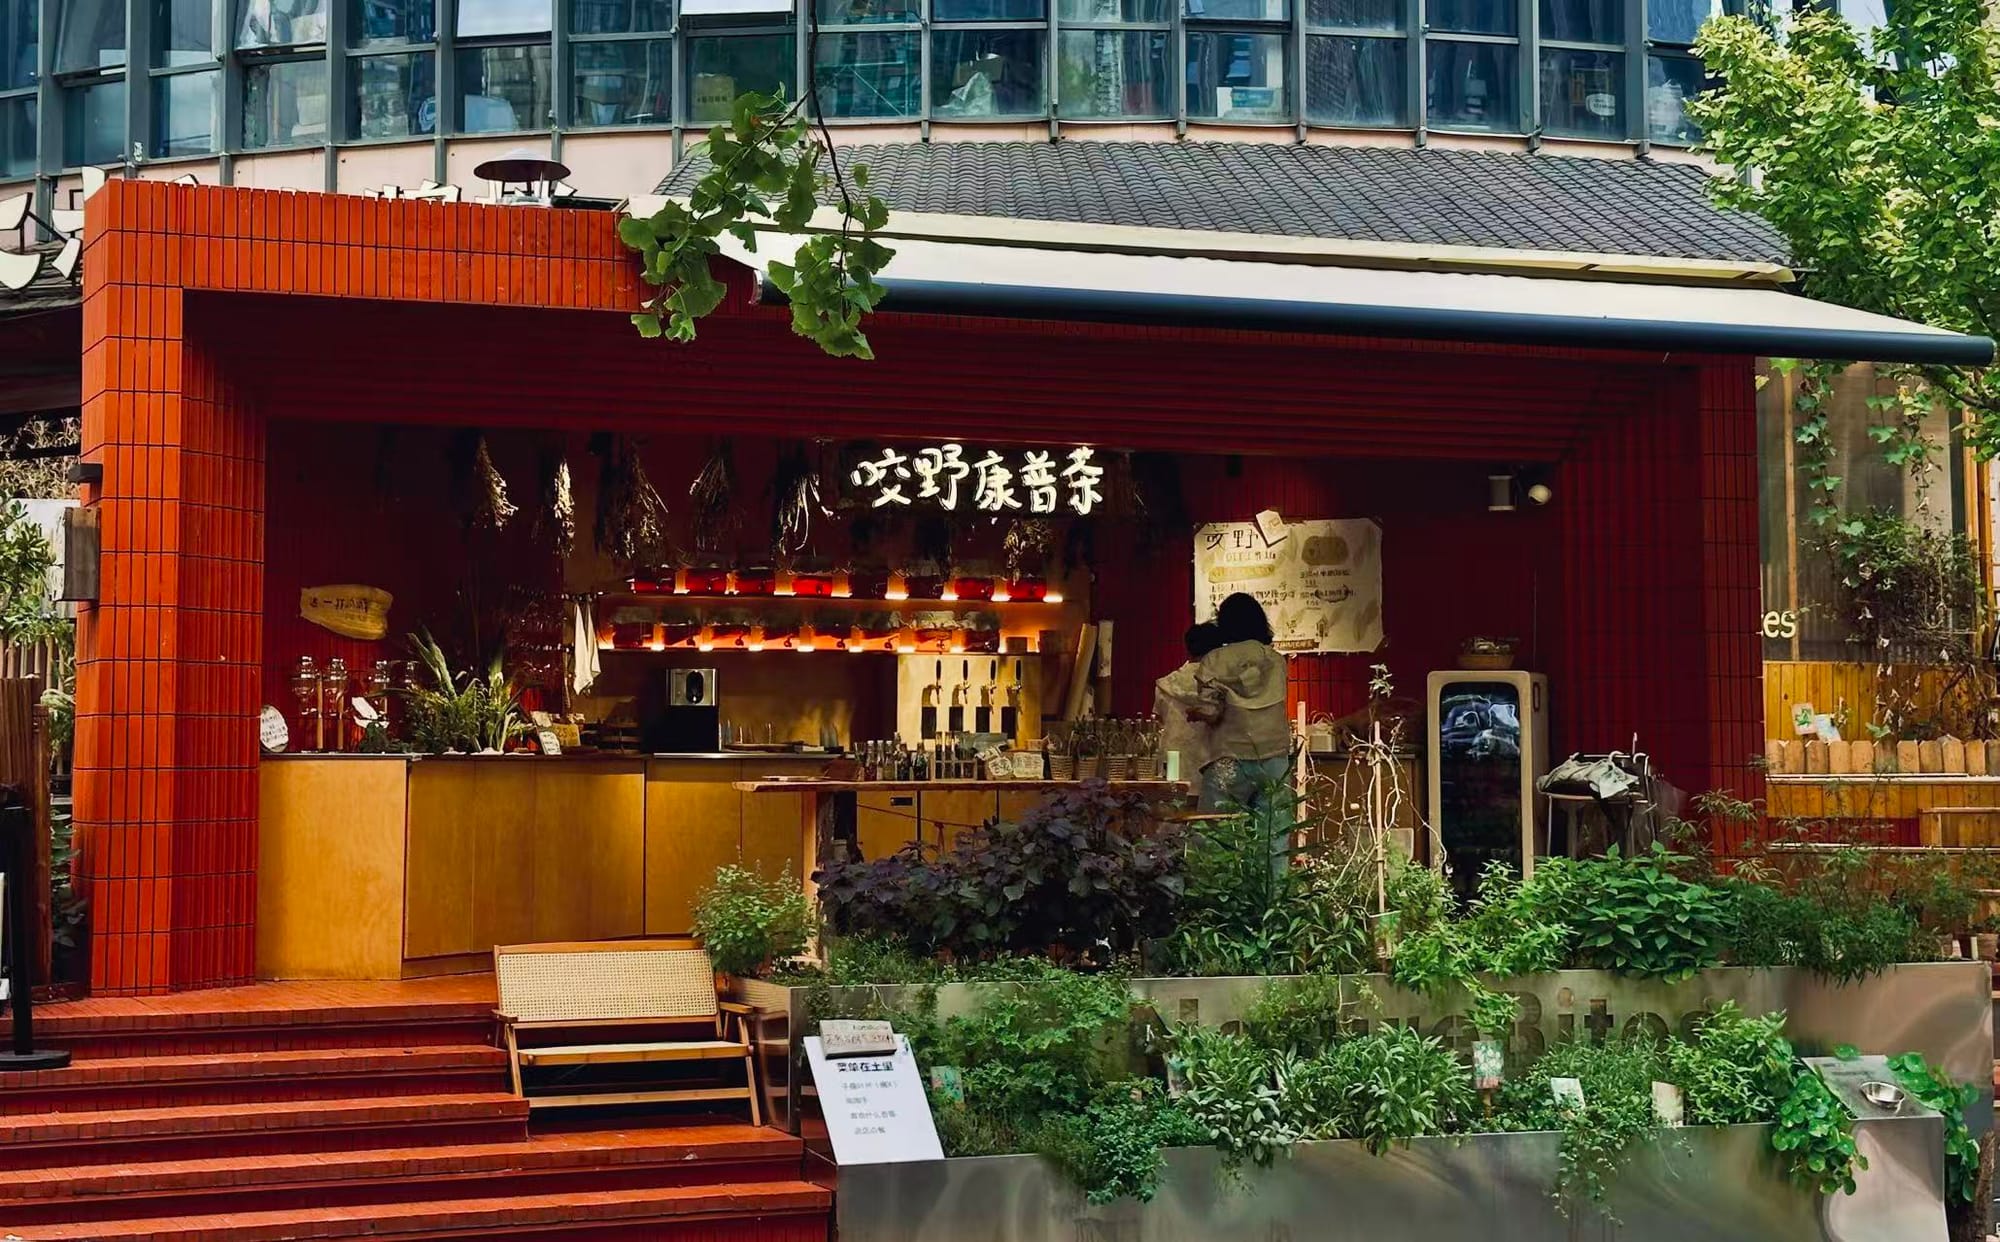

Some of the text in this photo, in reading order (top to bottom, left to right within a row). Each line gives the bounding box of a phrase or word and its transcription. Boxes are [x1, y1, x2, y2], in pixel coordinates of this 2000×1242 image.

[850, 443, 1104, 515] 咬野康普茶
